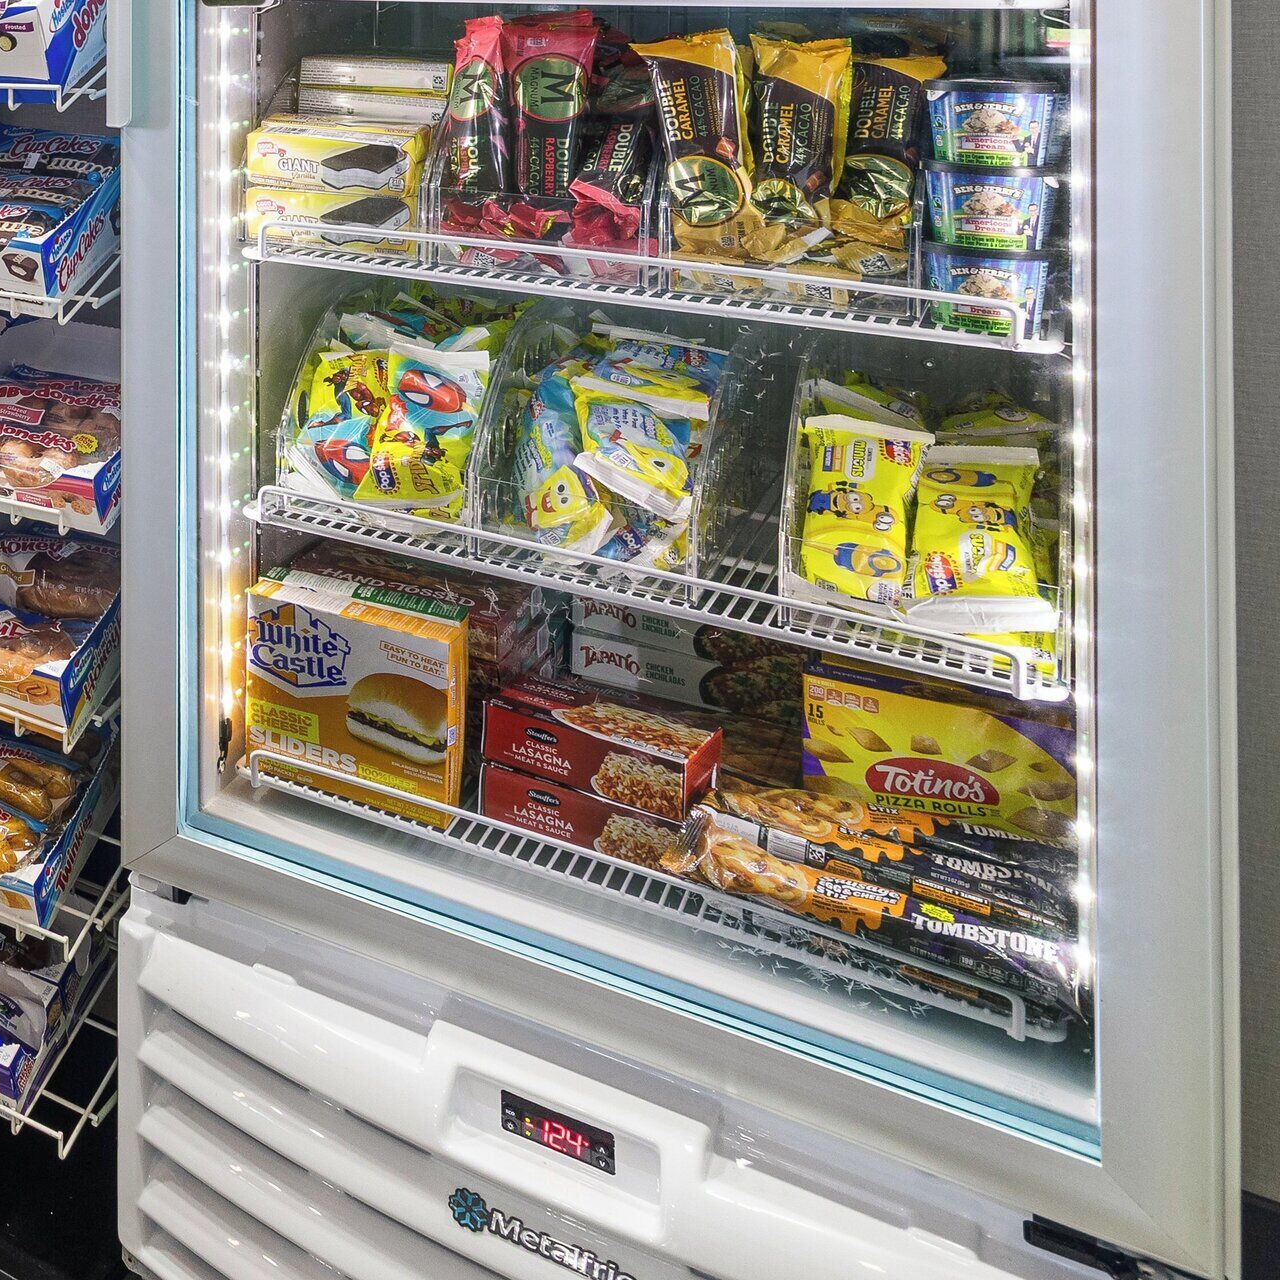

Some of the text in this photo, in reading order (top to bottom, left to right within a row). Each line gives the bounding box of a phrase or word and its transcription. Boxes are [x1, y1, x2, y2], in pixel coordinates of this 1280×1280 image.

[657, 78, 681, 143] DOUBLE
[670, 78, 695, 142] CARAMEL
[853, 83, 877, 140] DOUBLE
[871, 85, 895, 141] CARAMEL
[776, 103, 796, 166] CARAMEL
[8, 136, 99, 158] CupCakes
[974, 142, 1007, 150] Dream
[277, 157, 320, 174] GIANT
[544, 136, 555, 197] RASPBERRY
[974, 225, 1006, 233] Dream
[56, 214, 104, 294] CupCakes
[0, 408, 32, 422] Strawberry
[6, 404, 28, 414] Glazed
[317, 567, 385, 588] HAND
[255, 619, 339, 657] White
[384, 642, 404, 656] EASY
[406, 649, 420, 659] TO
[390, 652, 409, 665] FUN
[410, 658, 422, 668] TO
[252, 643, 343, 682] Castle
[645, 662, 675, 676] CHICKEN
[645, 670, 687, 687] ENCHILADAS
[250, 702, 313, 728] CLASSIC
[808, 702, 824, 719] 15
[251, 712, 309, 738] CHEESE
[808, 717, 826, 727] ROLLS
[525, 728, 558, 743] Stouffer's
[249, 724, 357, 774] SLIDERS
[512, 743, 573, 770] LASAGNA
[525, 740, 558, 755] CLASSIC
[514, 754, 535, 766] MEAT
[543, 761, 569, 776] SAUCE
[874, 764, 986, 803] Totino's
[527, 789, 561, 806] Stouffer's
[875, 794, 987, 817] PIZZA ROLLS
[513, 805, 575, 832] LASAGNA
[527, 802, 560, 817] CLASSIC
[515, 817, 537, 829] MEAT
[545, 824, 571, 839] SAUCE
[910, 912, 1061, 964] TOMBSTONE
